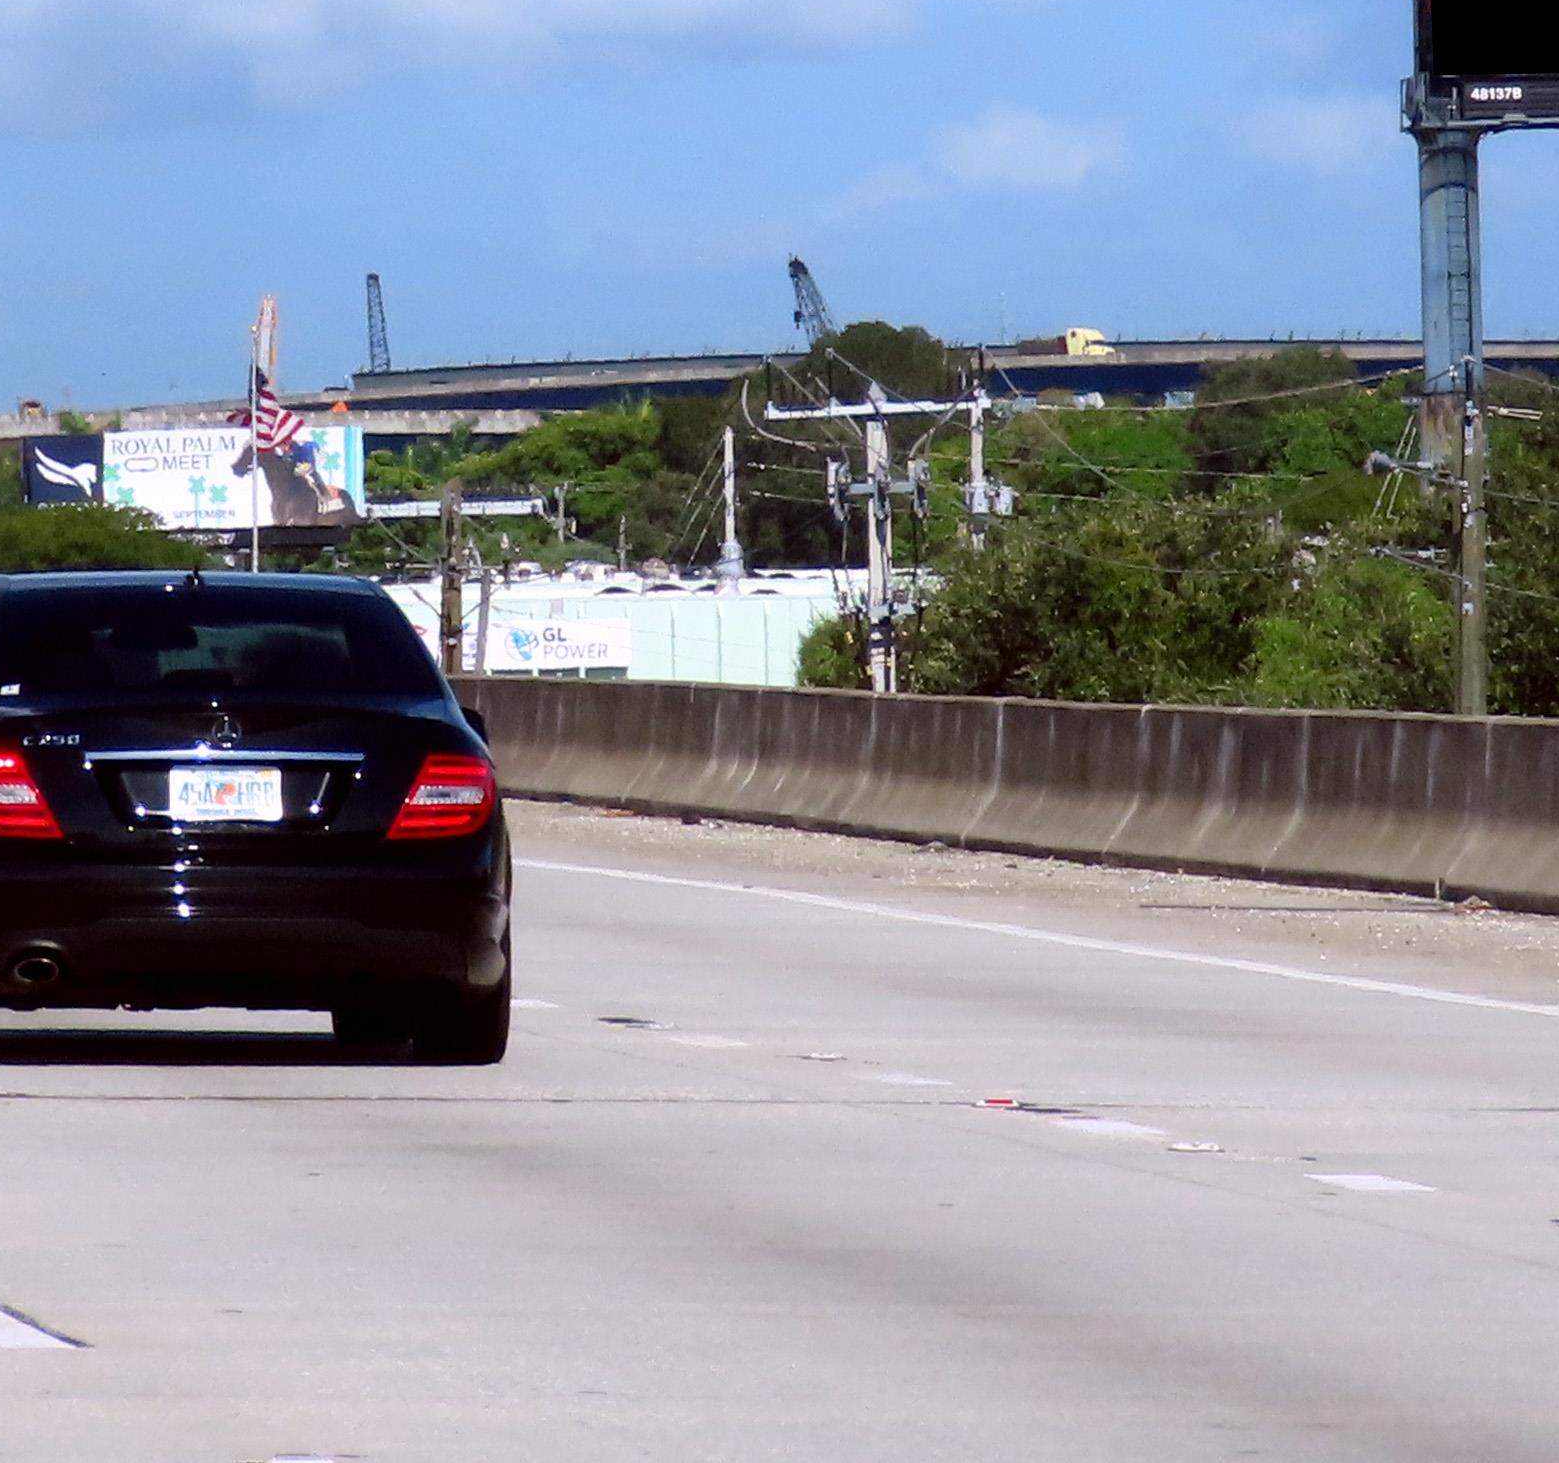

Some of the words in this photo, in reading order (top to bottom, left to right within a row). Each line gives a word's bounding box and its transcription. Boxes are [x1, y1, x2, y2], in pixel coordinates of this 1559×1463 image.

[111, 437, 177, 455] ROYAL
[182, 435, 237, 453] PALM
[162, 454, 213, 471] MEET
[542, 627, 567, 643] GL
[543, 643, 609, 659] POWER
